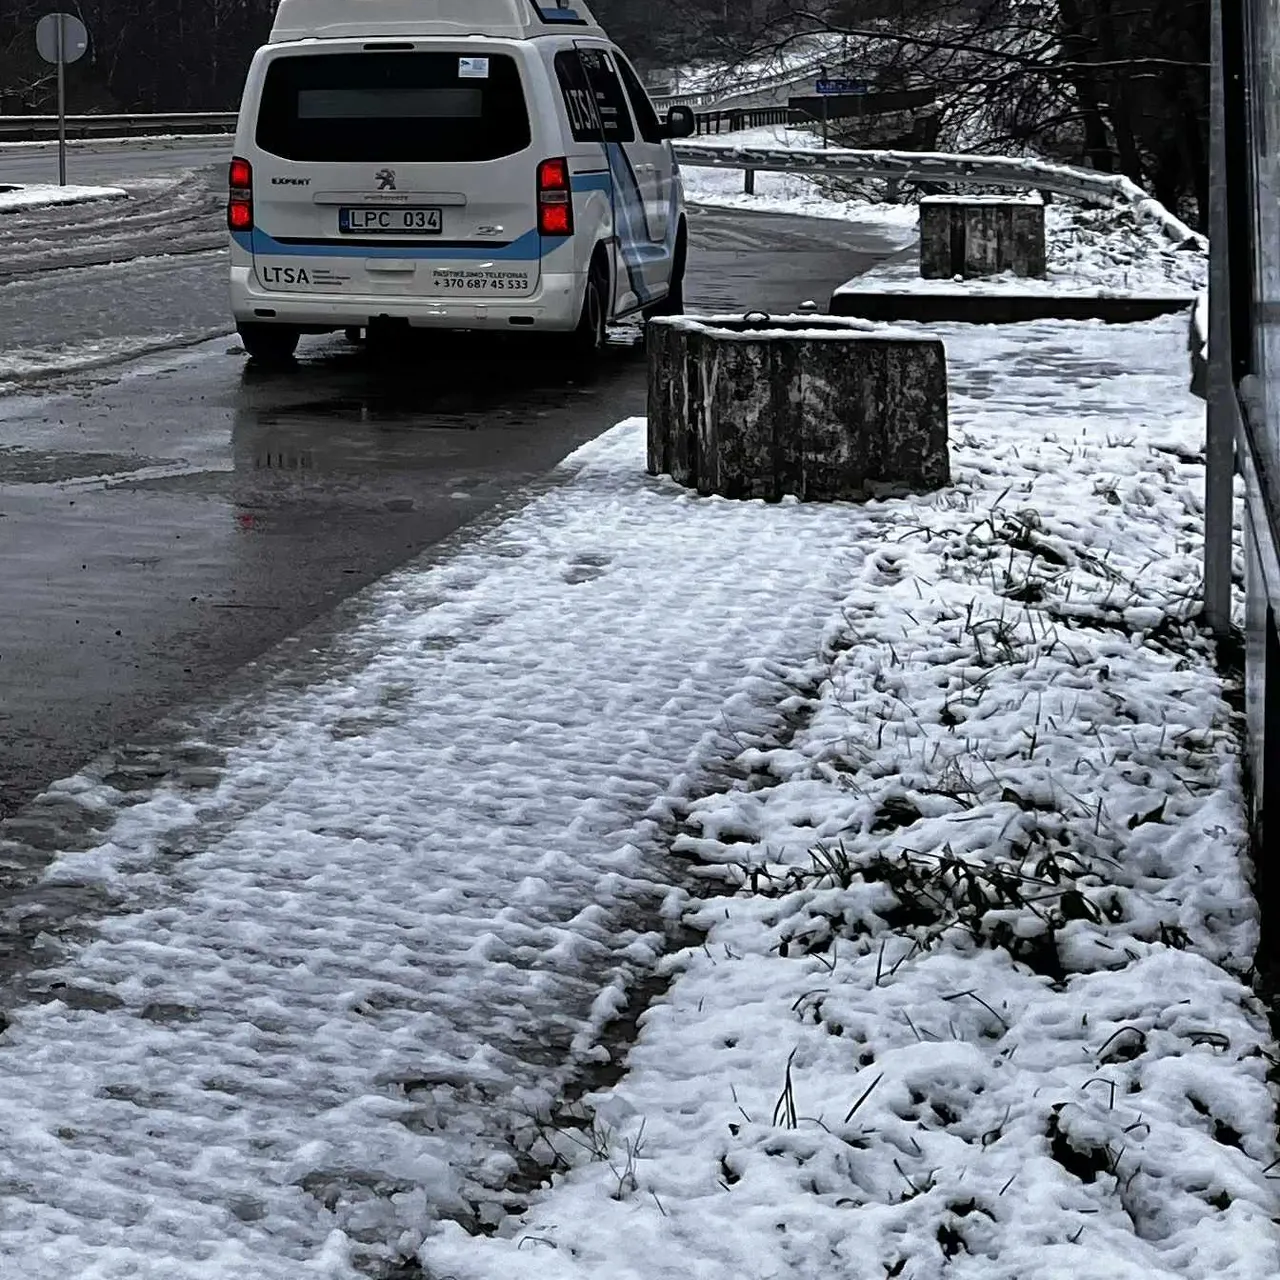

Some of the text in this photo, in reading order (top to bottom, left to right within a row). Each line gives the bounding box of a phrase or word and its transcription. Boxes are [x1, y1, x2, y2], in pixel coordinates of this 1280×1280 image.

[351, 211, 438, 228] LPC 034
[263, 266, 310, 284] LTSA
[443, 279, 464, 289] 370
[467, 279, 487, 289] 687
[491, 280, 505, 290] 45
[507, 280, 528, 290] 533
